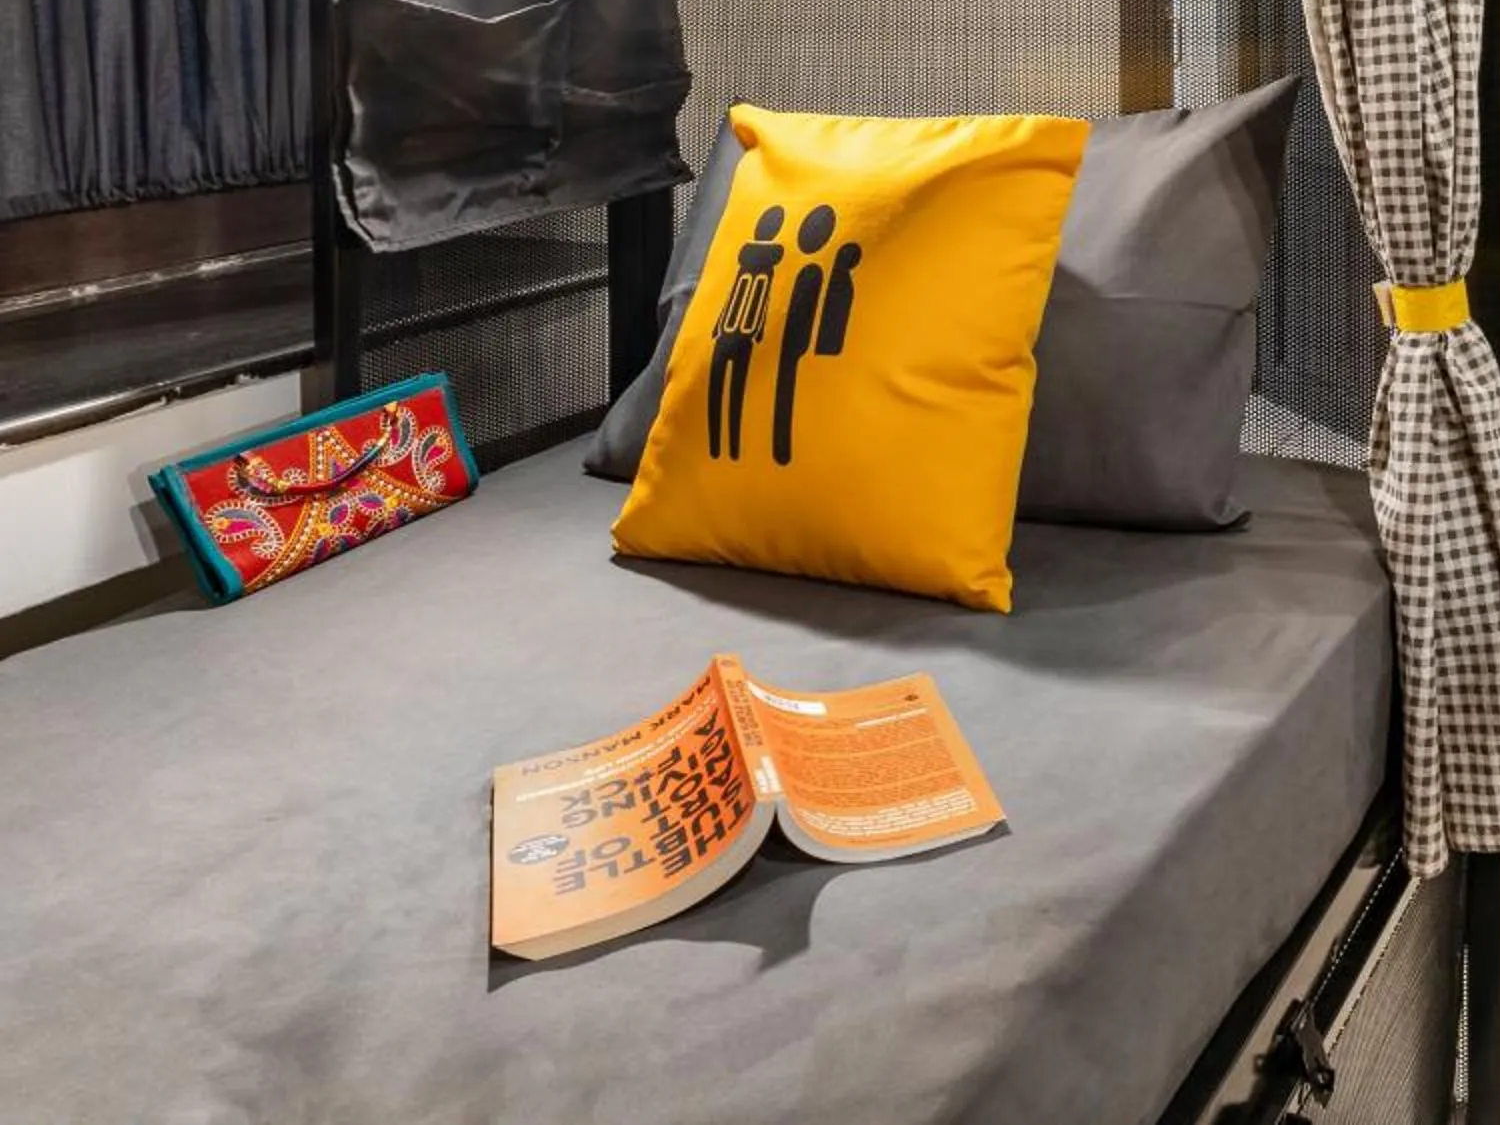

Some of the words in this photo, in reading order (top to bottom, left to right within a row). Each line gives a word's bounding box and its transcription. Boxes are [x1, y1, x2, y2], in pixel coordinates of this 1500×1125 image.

[649, 675, 712, 730] MARK
[693, 707, 720, 736] A
[521, 731, 642, 775] MANSON
[562, 728, 726, 830] GIVING
[641, 741, 732, 824] NOT
[553, 779, 743, 896] SUBTLE
[650, 760, 734, 841] ART
[555, 836, 632, 874] OF
[662, 802, 749, 879] THE
